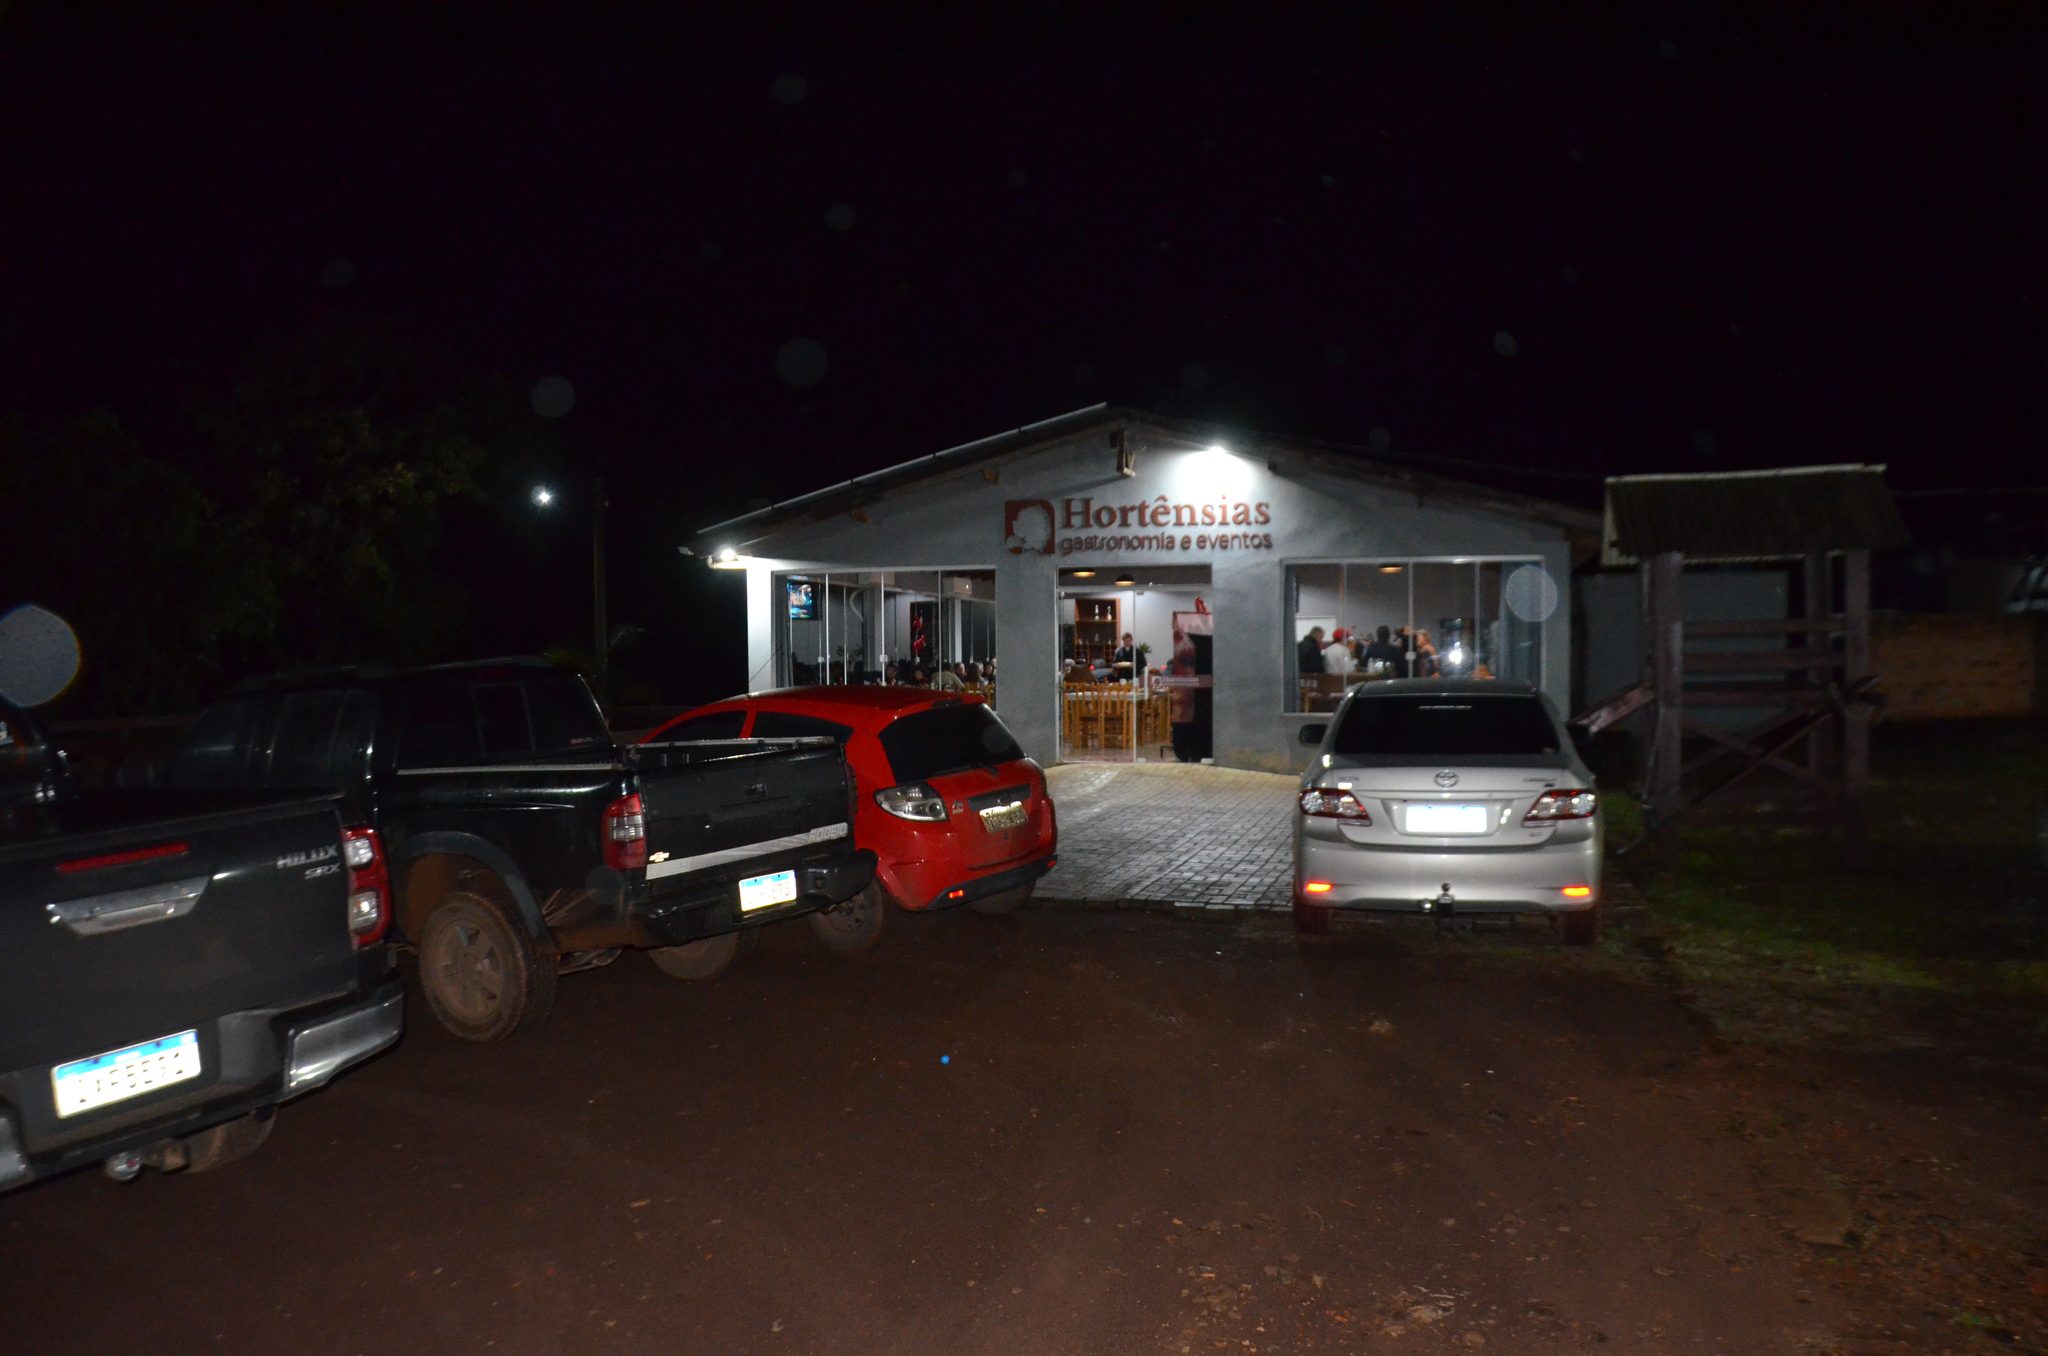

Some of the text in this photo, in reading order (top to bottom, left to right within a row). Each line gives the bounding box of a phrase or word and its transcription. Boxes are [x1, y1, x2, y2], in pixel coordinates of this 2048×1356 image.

[1062, 495, 1271, 529] Hortênsias
[1062, 532, 1273, 555] gastronomia e eventos
[277, 845, 339, 868] HILUX
